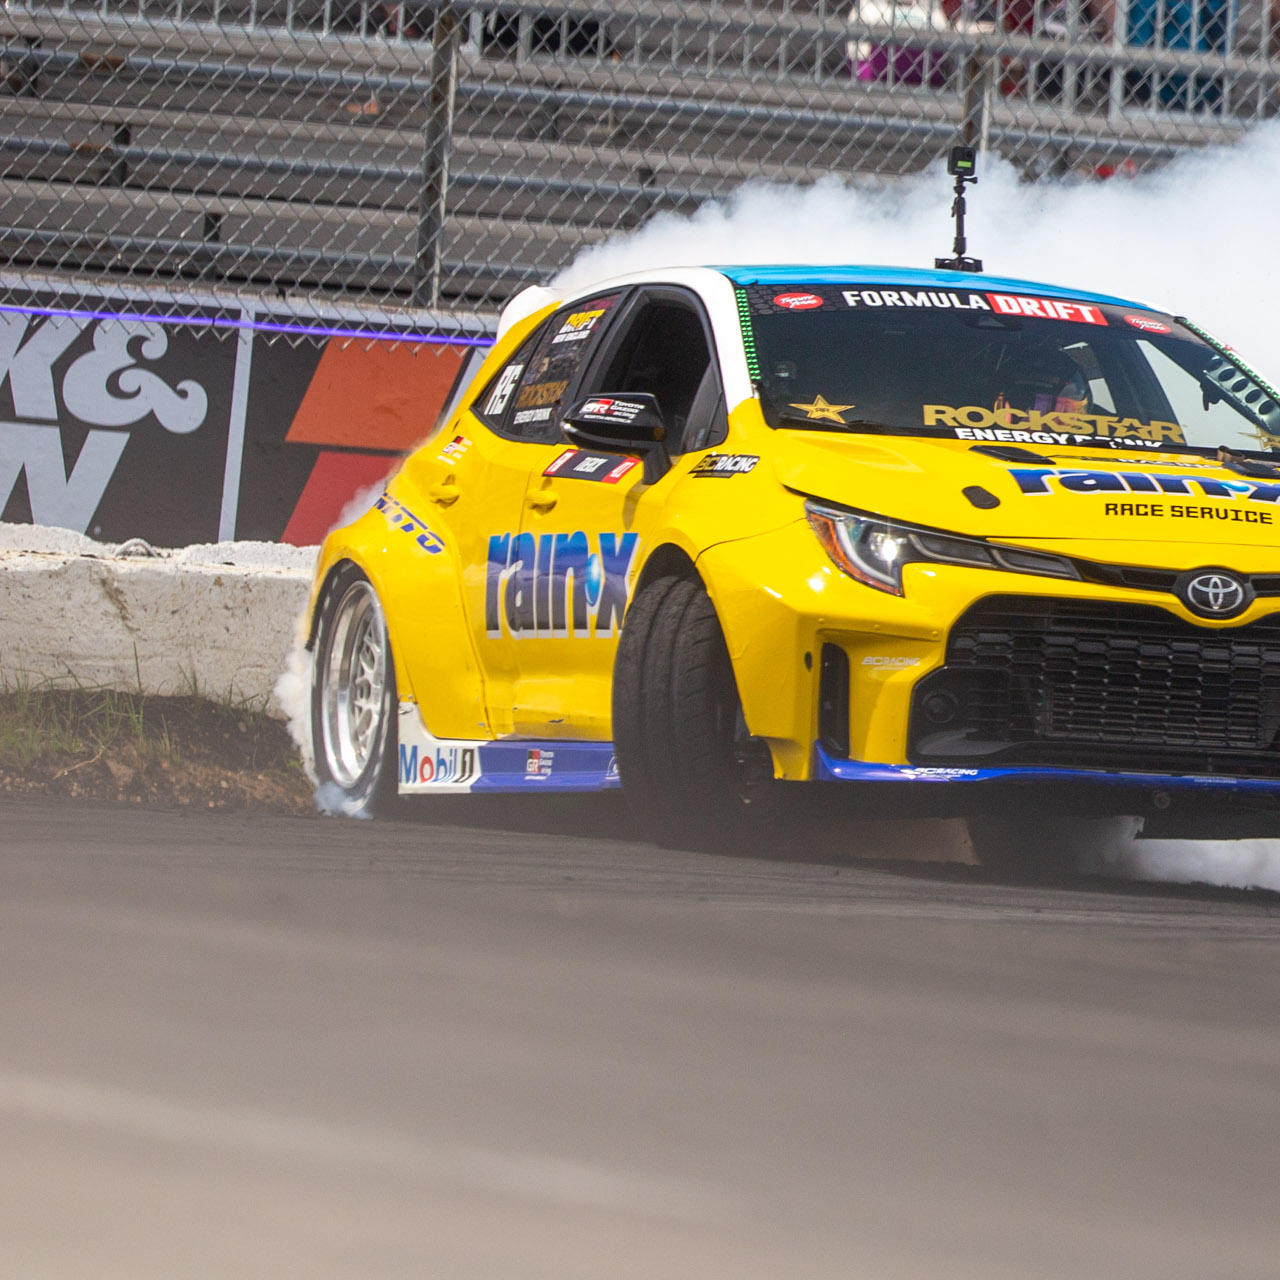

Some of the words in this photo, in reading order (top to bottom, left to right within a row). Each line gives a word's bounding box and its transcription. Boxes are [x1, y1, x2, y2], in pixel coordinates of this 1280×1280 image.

[842, 290, 991, 311] FORMULA
[994, 295, 1095, 324] DRIFT
[922, 405, 1184, 444] ROCKSTAR
[954, 427, 1069, 445] ENERGY
[1104, 502, 1165, 519] RACE
[1170, 504, 1274, 526] SERVICE
[400, 743, 457, 785] Mobil
[453, 748, 475, 784] 1
